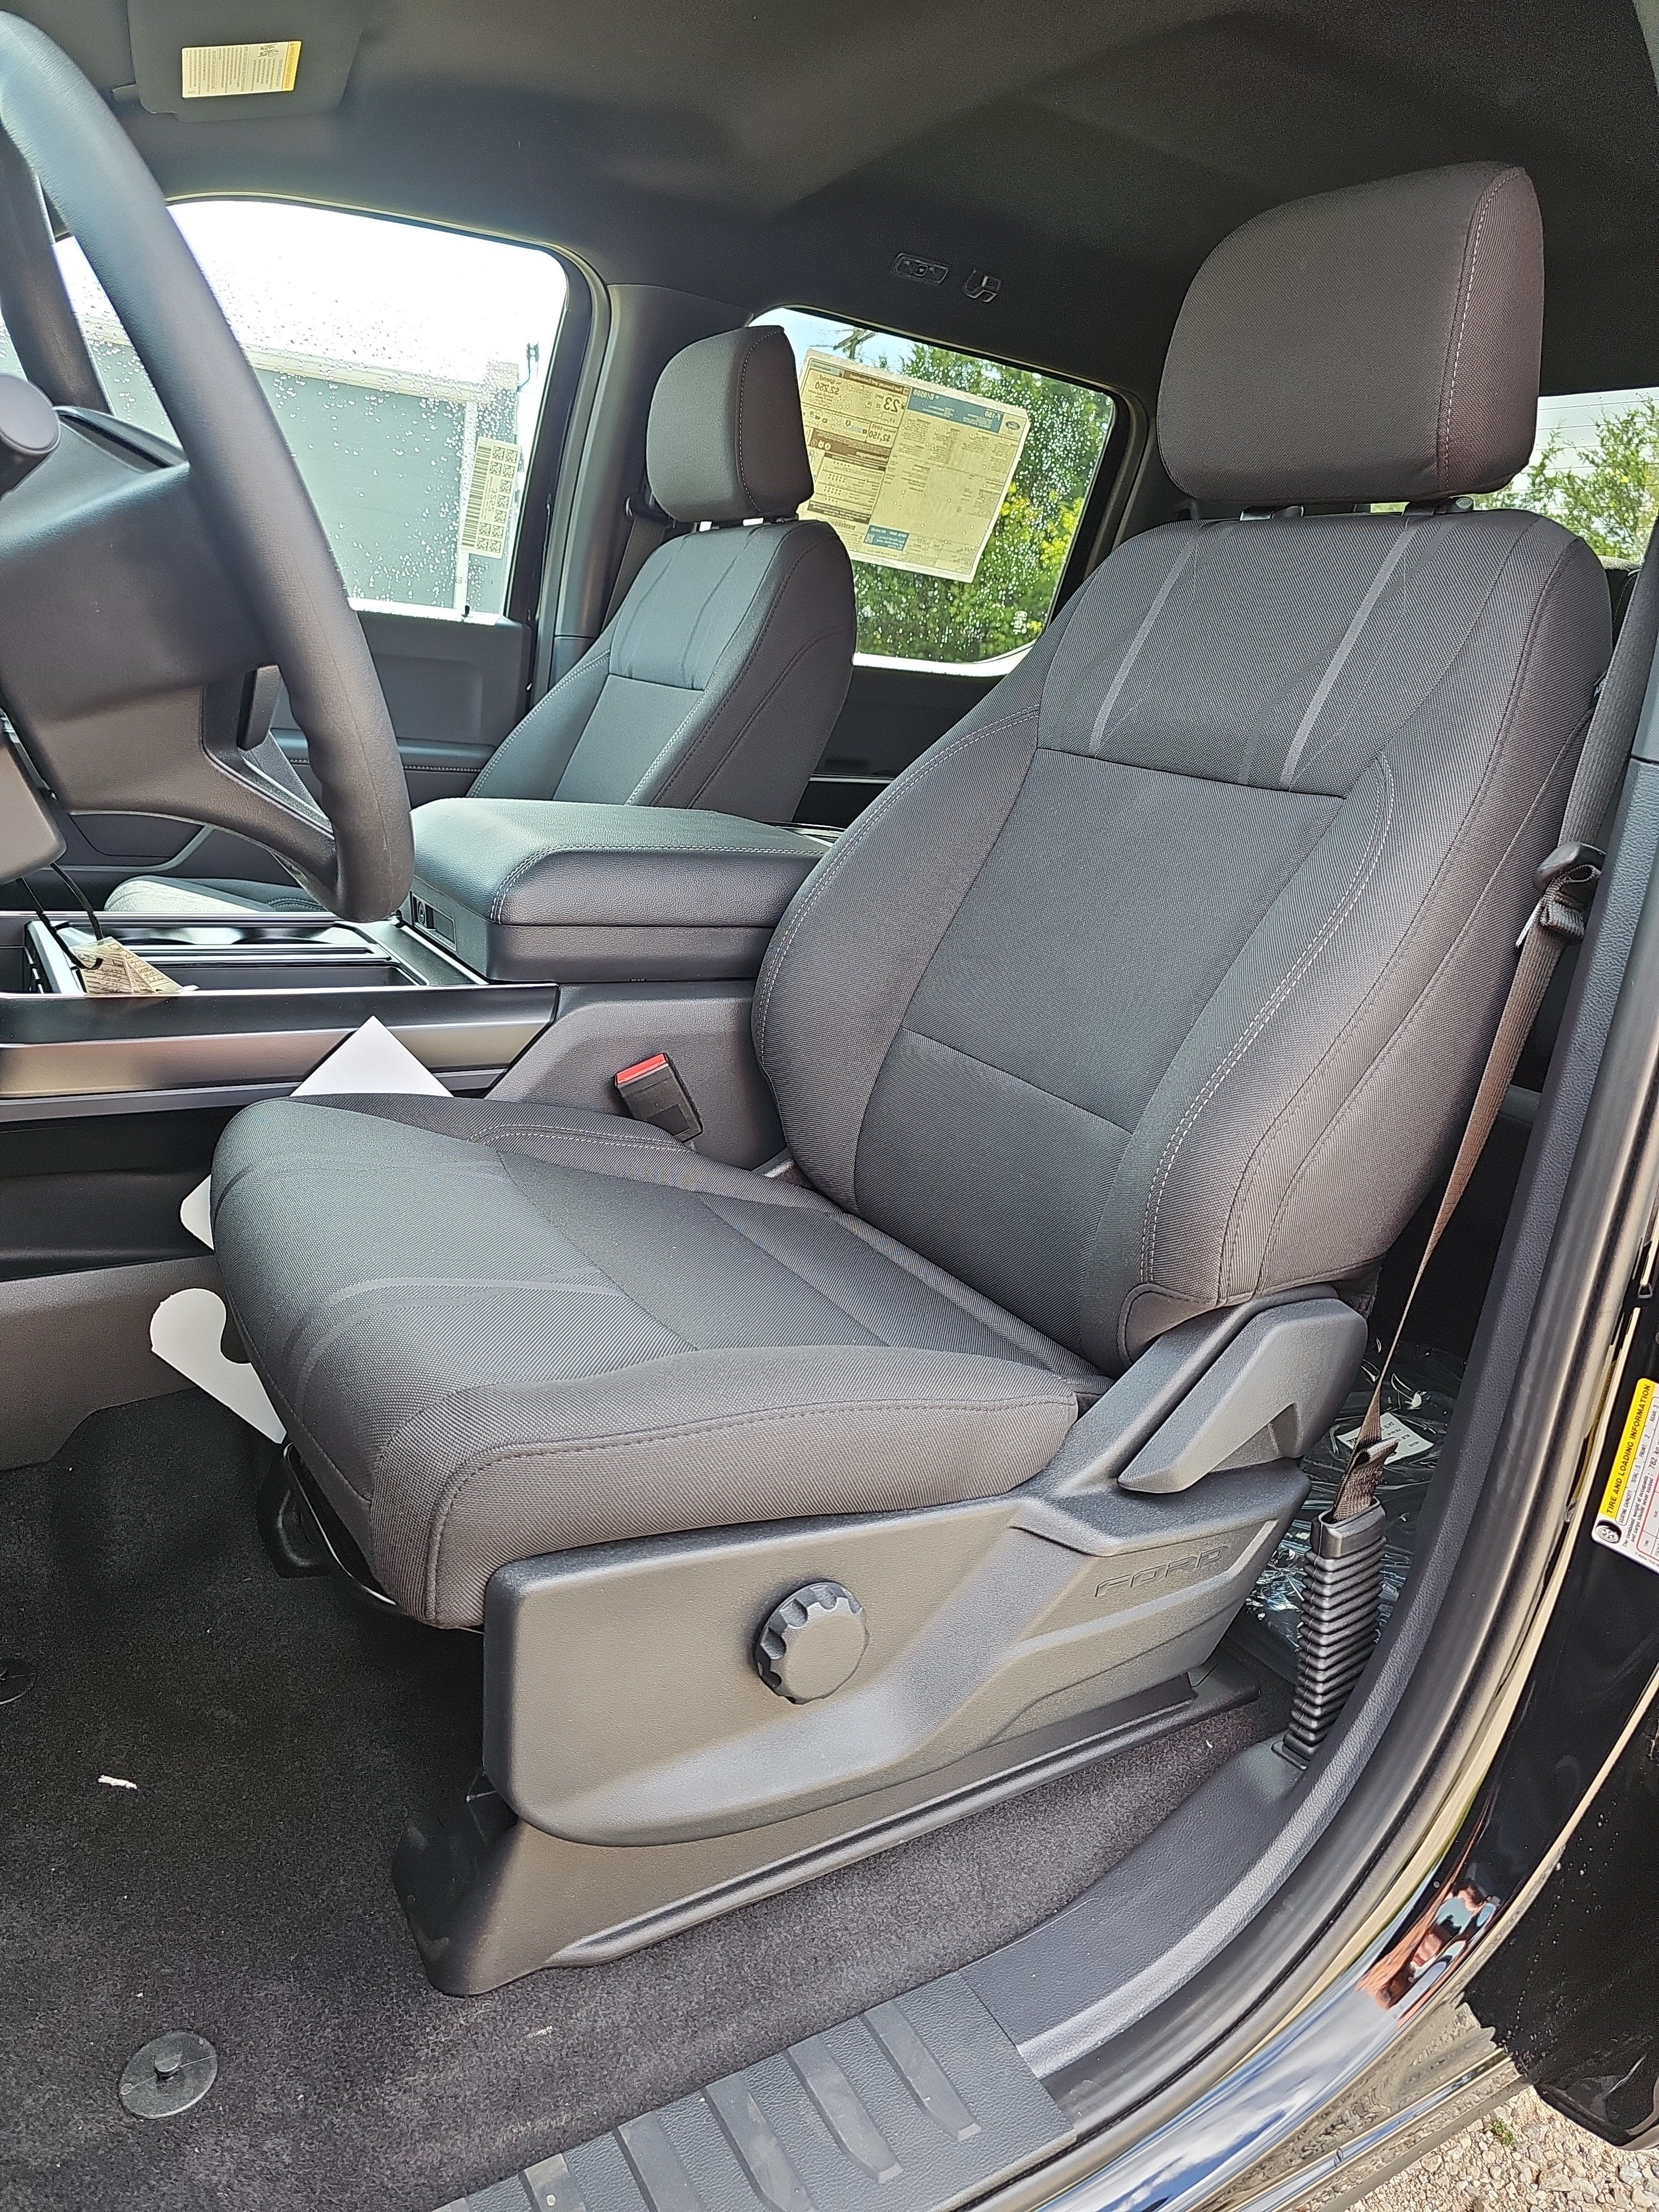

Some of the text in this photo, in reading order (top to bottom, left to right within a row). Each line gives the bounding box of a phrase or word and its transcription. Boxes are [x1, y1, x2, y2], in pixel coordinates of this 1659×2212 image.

[1606, 1384, 1651, 1514] TIRE AND LOADING INFORMATION
[1648, 1457, 1657, 1470] 782
[1626, 1517, 1635, 1539] combined
[1639, 1475, 1649, 1497] occupants
[1646, 1477, 1654, 1494] exceed
[1094, 1545, 1230, 1597] FORD
